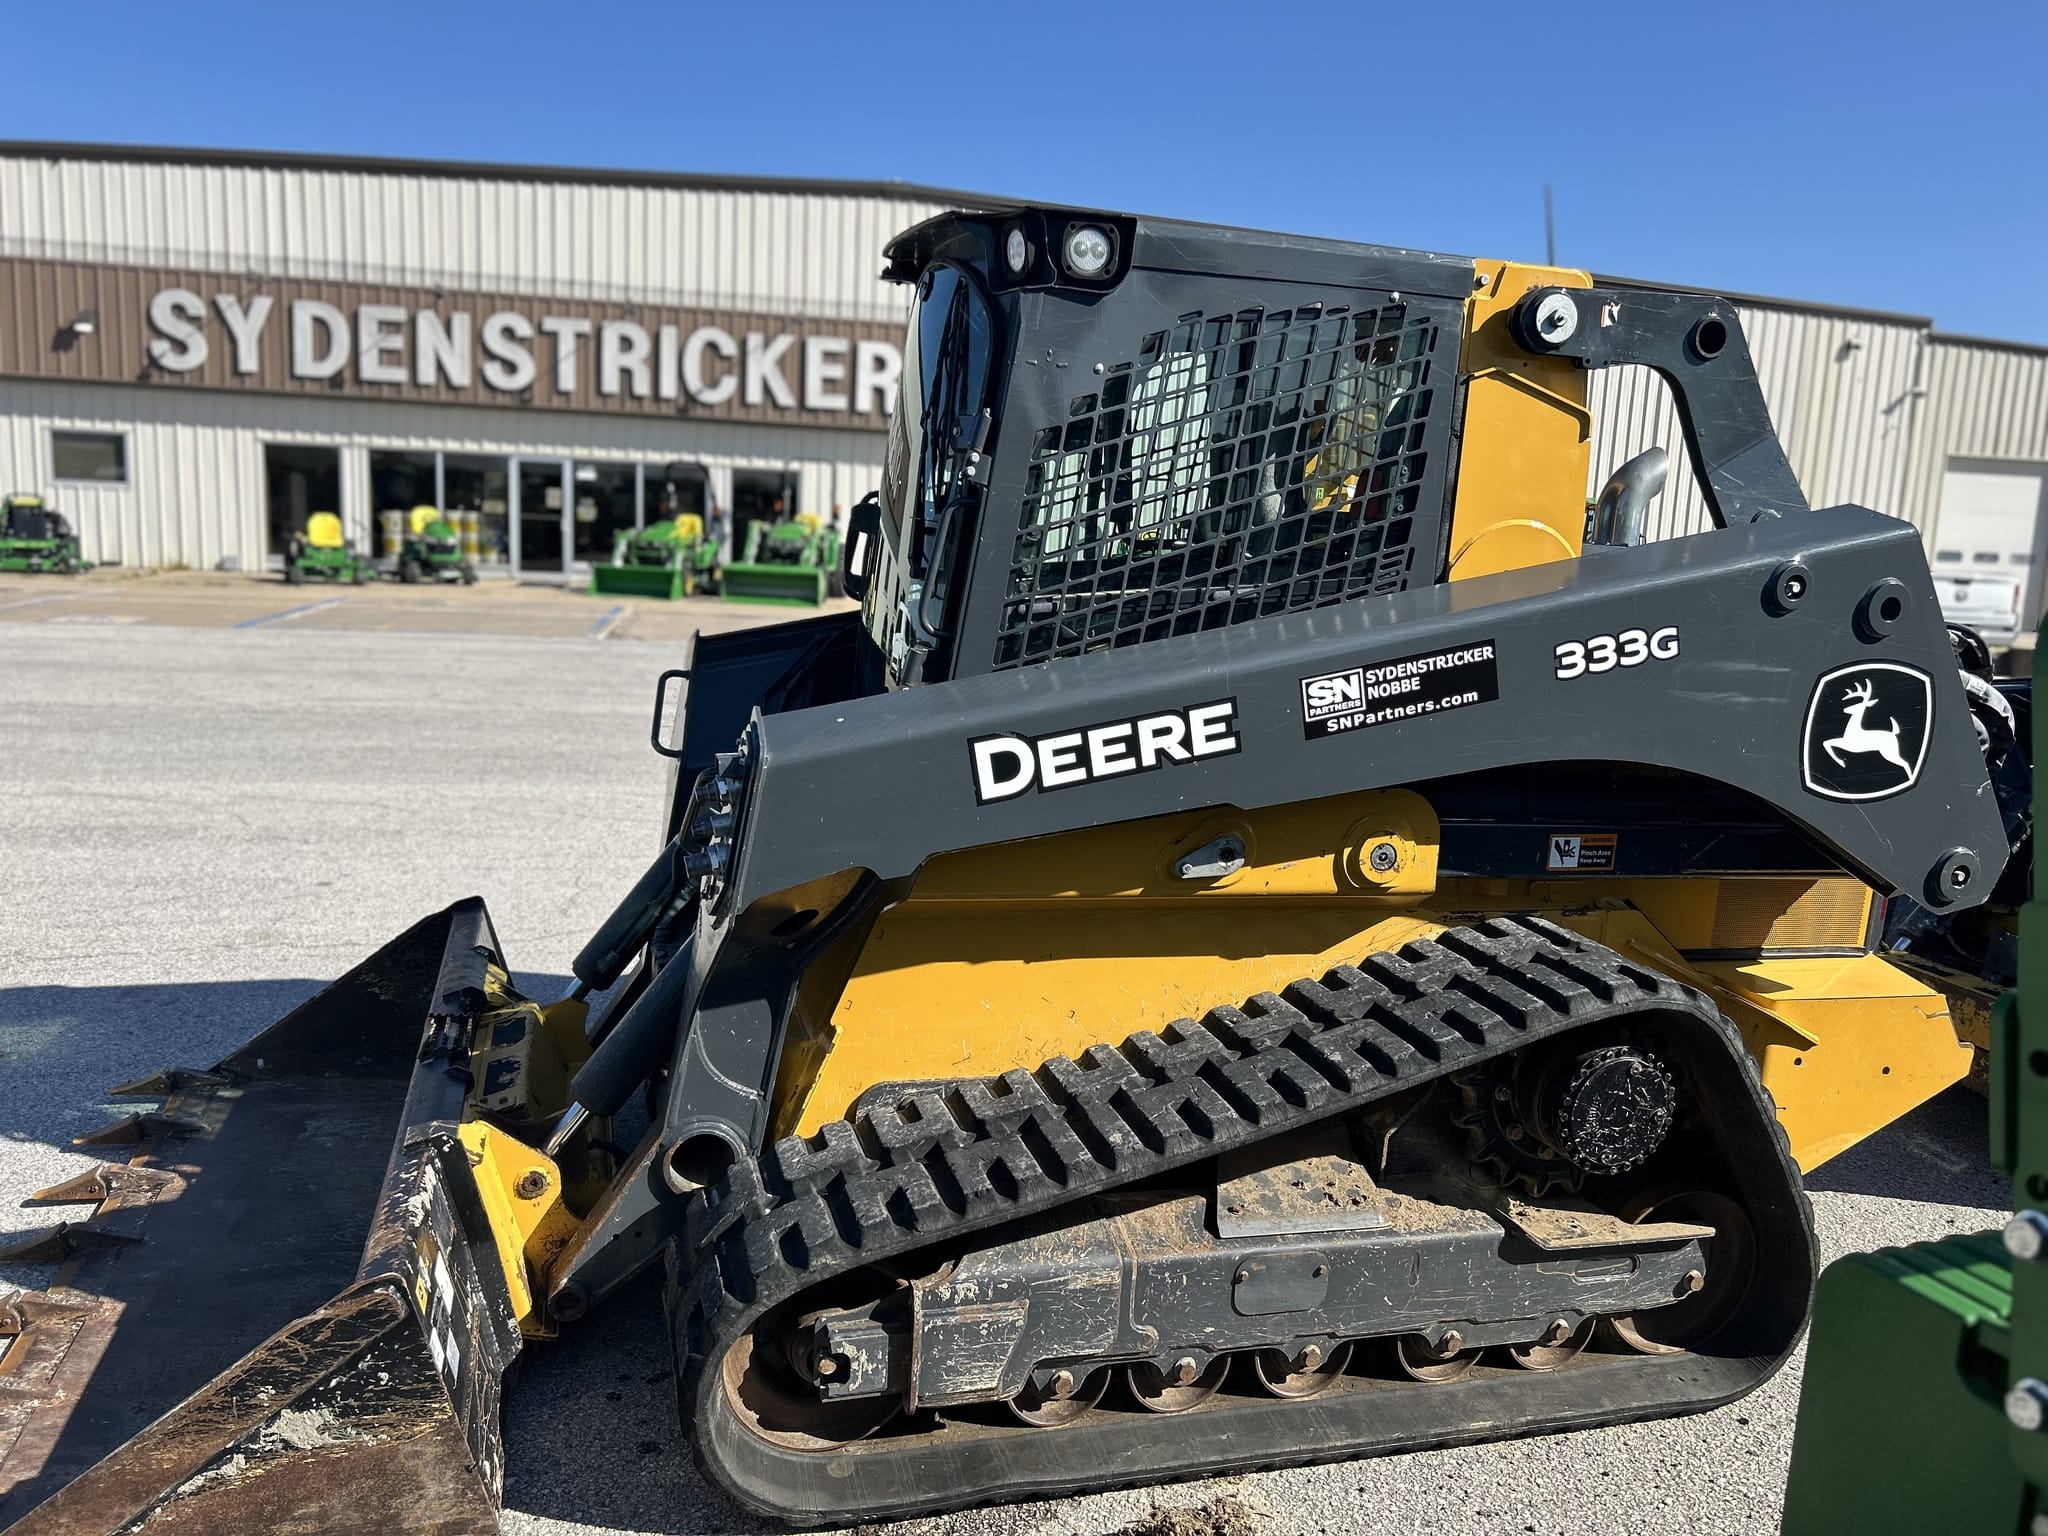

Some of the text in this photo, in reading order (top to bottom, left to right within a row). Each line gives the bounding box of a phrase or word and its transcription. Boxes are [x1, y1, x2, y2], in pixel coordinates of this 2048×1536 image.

[148, 288, 902, 414] SYDENSTRICKER
[1365, 645, 1495, 684] SYDENSTRICKER
[1555, 627, 1679, 679] 333G
[1309, 699, 1362, 717] PARTNERS
[1367, 676, 1421, 700] NOBBE
[1326, 690, 1479, 732] SNPartners.com
[972, 701, 1238, 801] DEERE
